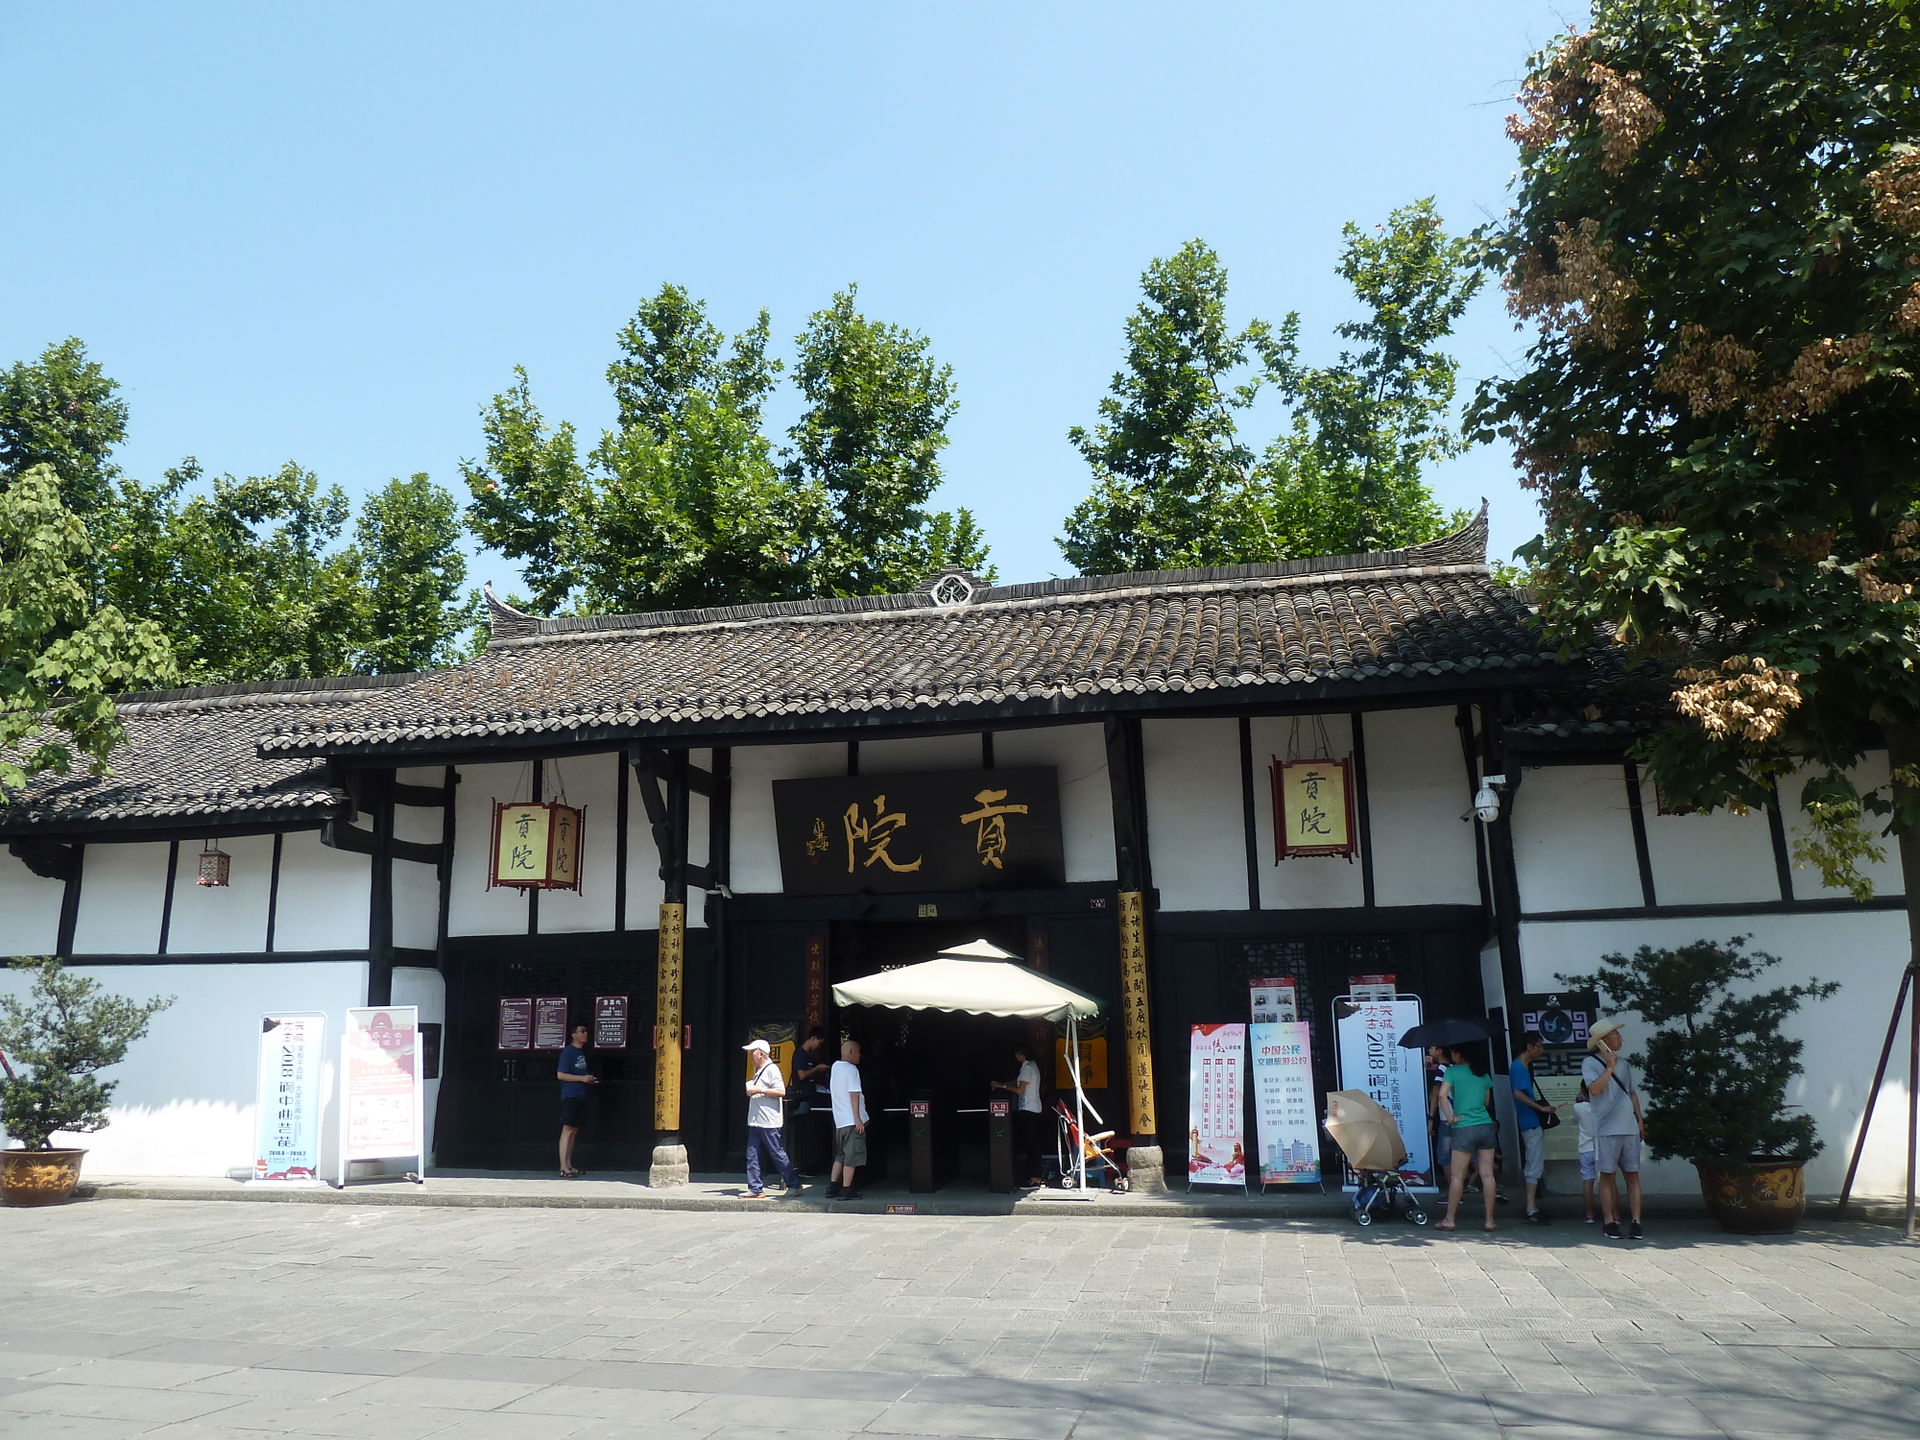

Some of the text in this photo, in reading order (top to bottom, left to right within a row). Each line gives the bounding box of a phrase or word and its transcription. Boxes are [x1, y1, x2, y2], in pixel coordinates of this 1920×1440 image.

[843, 789, 1028, 873] 貢院
[1300, 772, 1331, 834] 貢院
[511, 813, 536, 871] 貢院
[1258, 1057, 1307, 1066] 文明旅游公约
[1262, 1045, 1301, 1056] 中国公民
